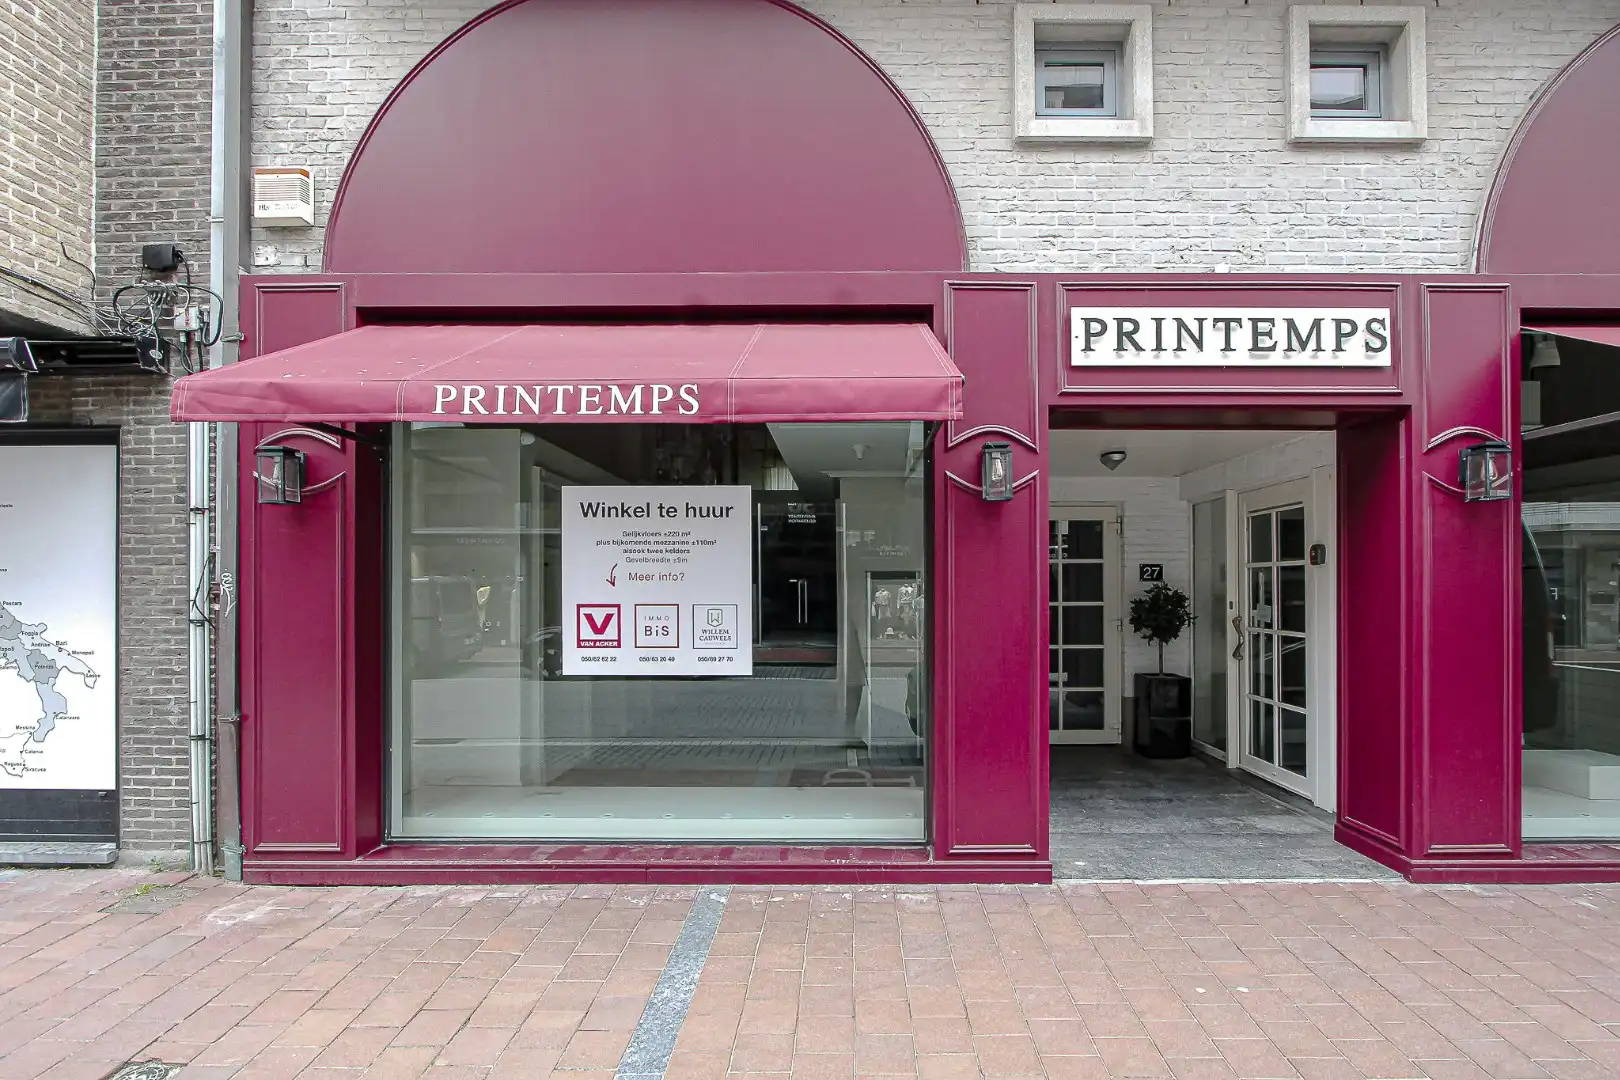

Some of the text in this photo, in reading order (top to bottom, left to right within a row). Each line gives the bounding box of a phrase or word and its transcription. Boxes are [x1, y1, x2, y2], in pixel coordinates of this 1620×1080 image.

[1080, 317, 1388, 353] PRINTEMPS
[431, 383, 700, 415] PRINTEMPS
[579, 501, 734, 518] Winkel te huur
[622, 530, 662, 538] Gelijkvloers
[596, 539, 611, 547] plus
[612, 539, 652, 547] bijkomende
[628, 572, 685, 582] Meer info?
[1143, 566, 1160, 579] 27
